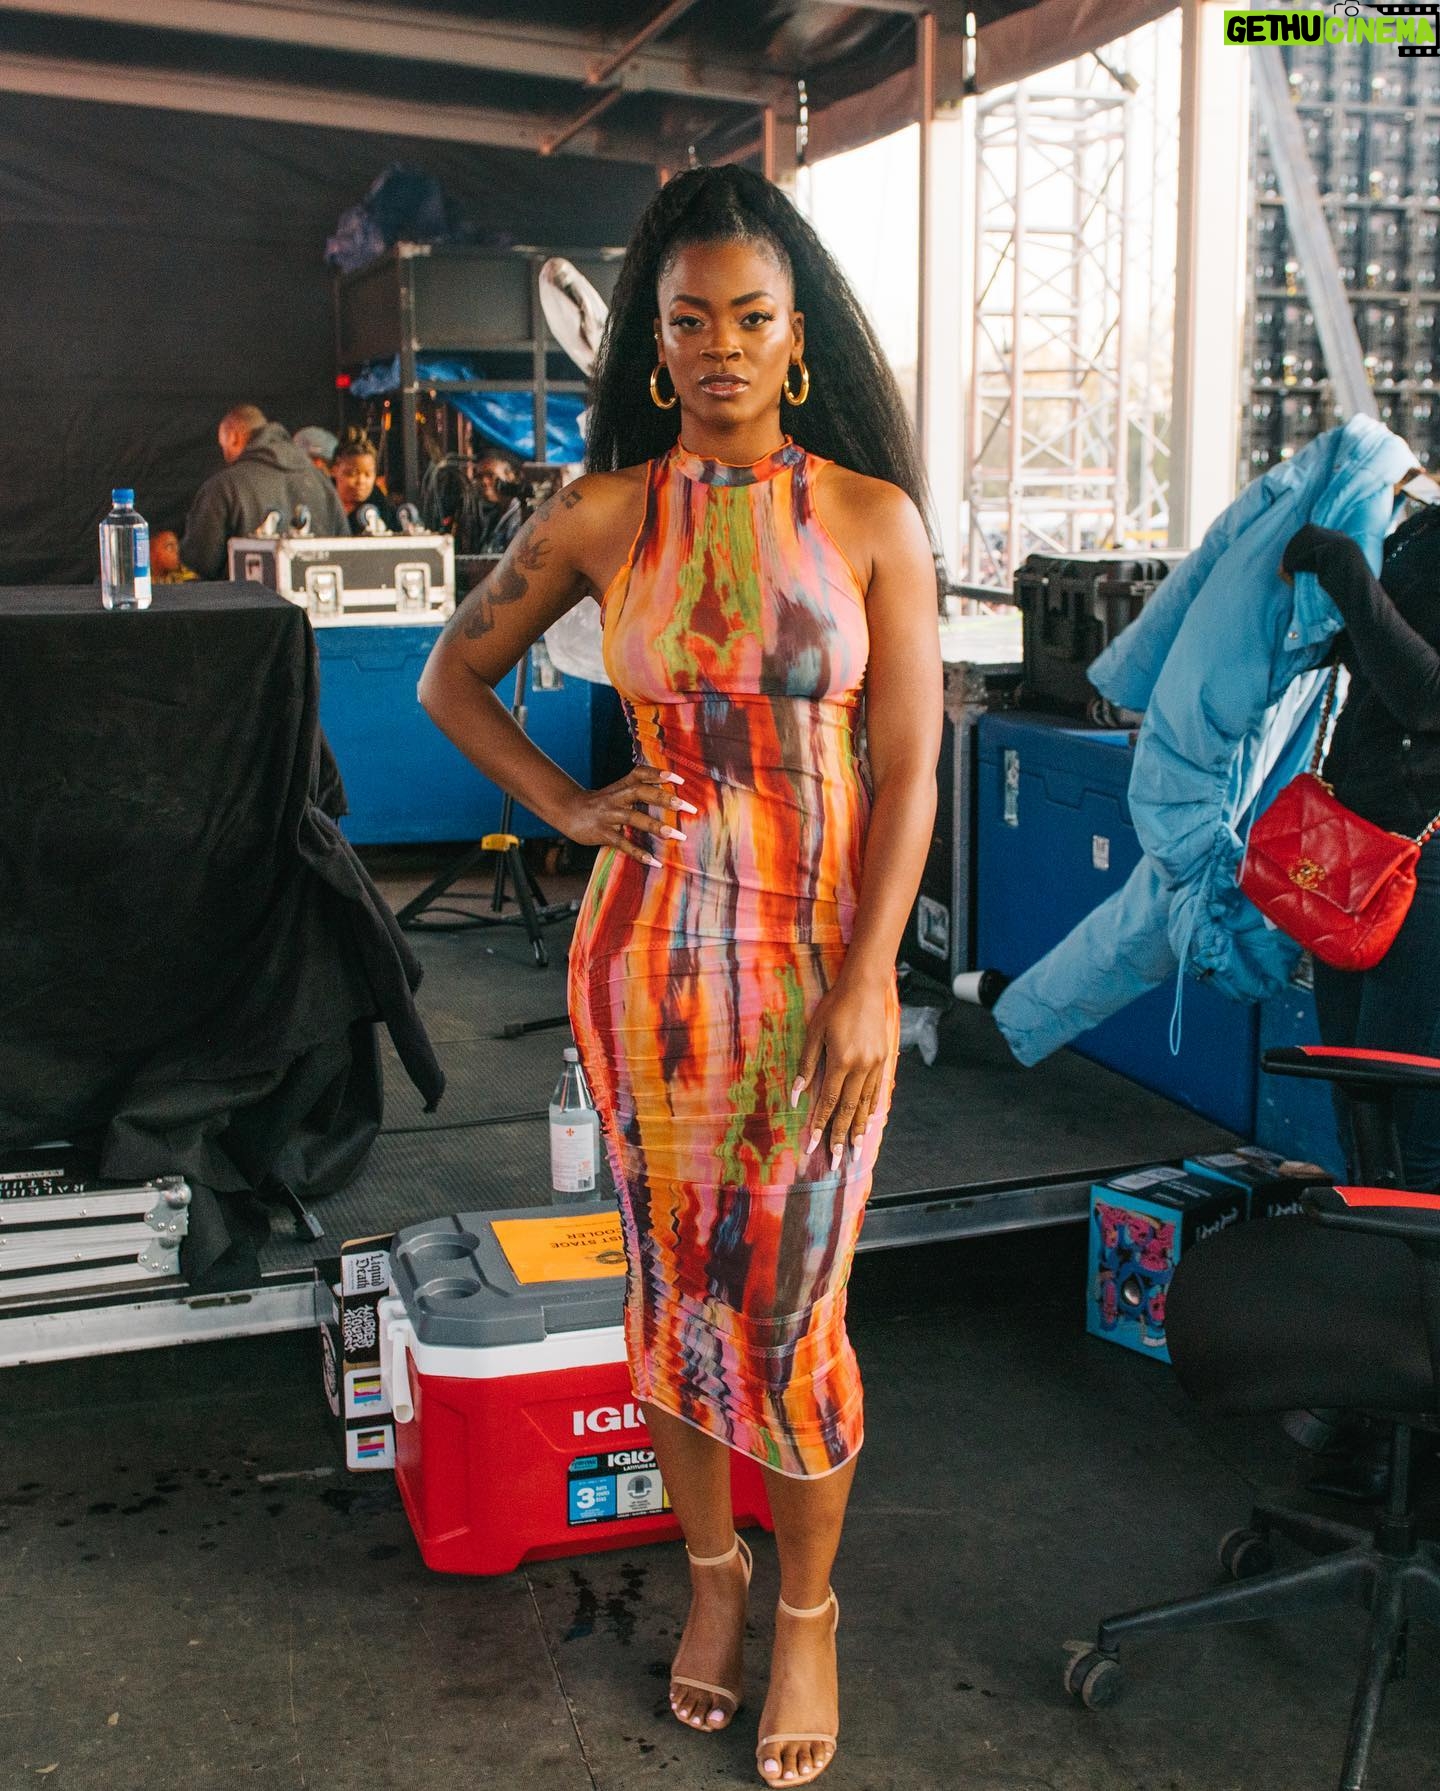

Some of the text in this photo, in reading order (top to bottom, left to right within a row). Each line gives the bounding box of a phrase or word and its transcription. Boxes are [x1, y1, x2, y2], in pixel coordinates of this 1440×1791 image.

[0, 1183, 84, 1198] RALEIG
[549, 1239, 597, 1249] STAGE
[355, 1258, 370, 1289] Death
[367, 1253, 385, 1287] Liquid
[577, 1488, 596, 1509] 3
